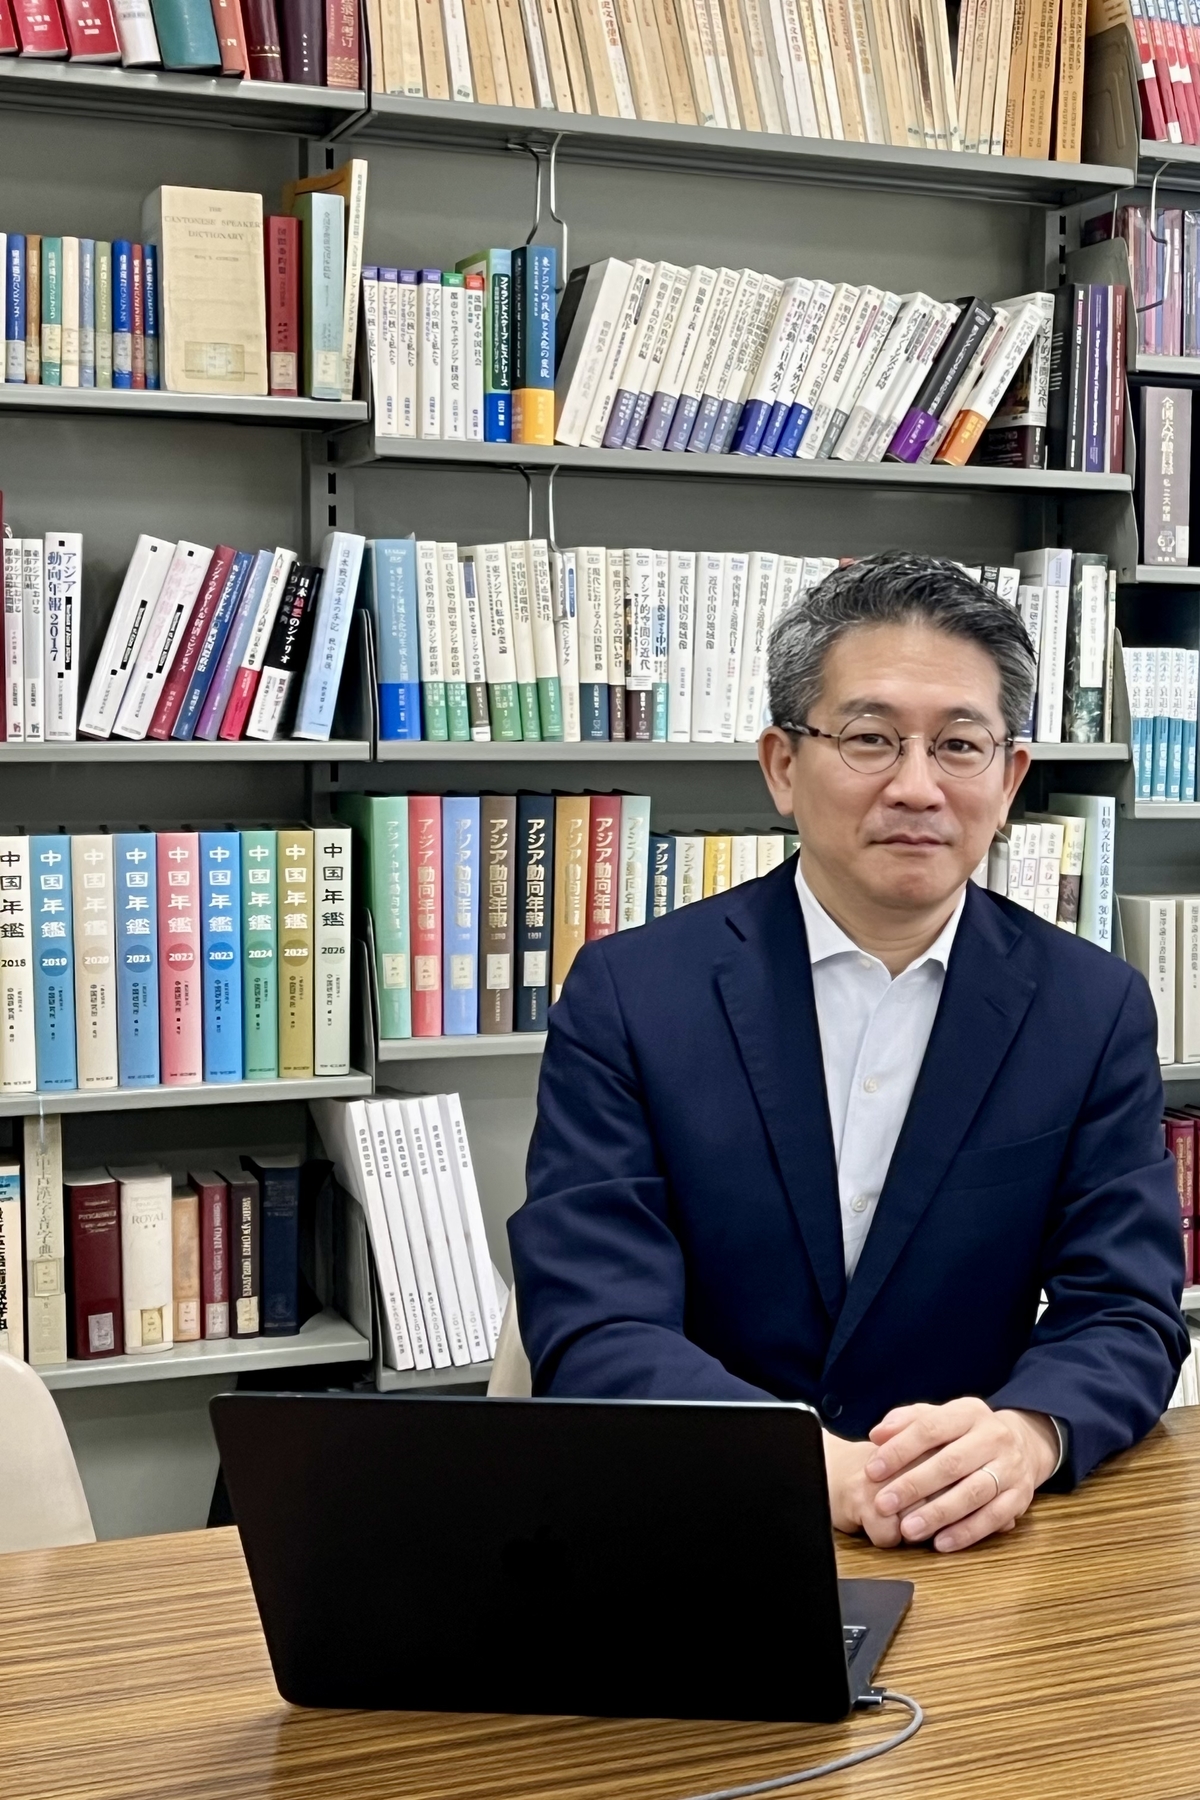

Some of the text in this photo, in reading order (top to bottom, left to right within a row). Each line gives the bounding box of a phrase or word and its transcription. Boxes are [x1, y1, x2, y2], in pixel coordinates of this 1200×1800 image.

[188, 230, 244, 241] DICTIONARY
[63, 552, 76, 593] アジア
[640, 575, 650, 670] アジア的空間の近代
[0, 851, 25, 938] 中国年鑑
[40, 850, 66, 938] 中国年鑑
[83, 848, 108, 936] 中国年鑑
[125, 848, 151, 936] 中国年鑑
[167, 847, 193, 933] 中国年鑑
[208, 846, 233, 932] 中国年鑑
[247, 845, 272, 931] 中国年鑑
[284, 844, 308, 930] 中国年鑑
[321, 843, 345, 927] 中国年鑑
[417, 818, 436, 931] アジア動向年報
[488, 818, 508, 928] アジア動向年報
[525, 818, 545, 928] アジア動向年報
[593, 817, 613, 925] アジア動向年報
[1, 958, 26, 968] 2018
[42, 958, 67, 967] 2019
[84, 956, 109, 965] 2020
[126, 954, 151, 963] 2021
[168, 952, 194, 961] 2022
[209, 951, 234, 960] 2023
[248, 950, 273, 958] 2024
[284, 948, 308, 957] 2025
[321, 946, 345, 955] 2026
[131, 1213, 167, 1226] ROYAL
